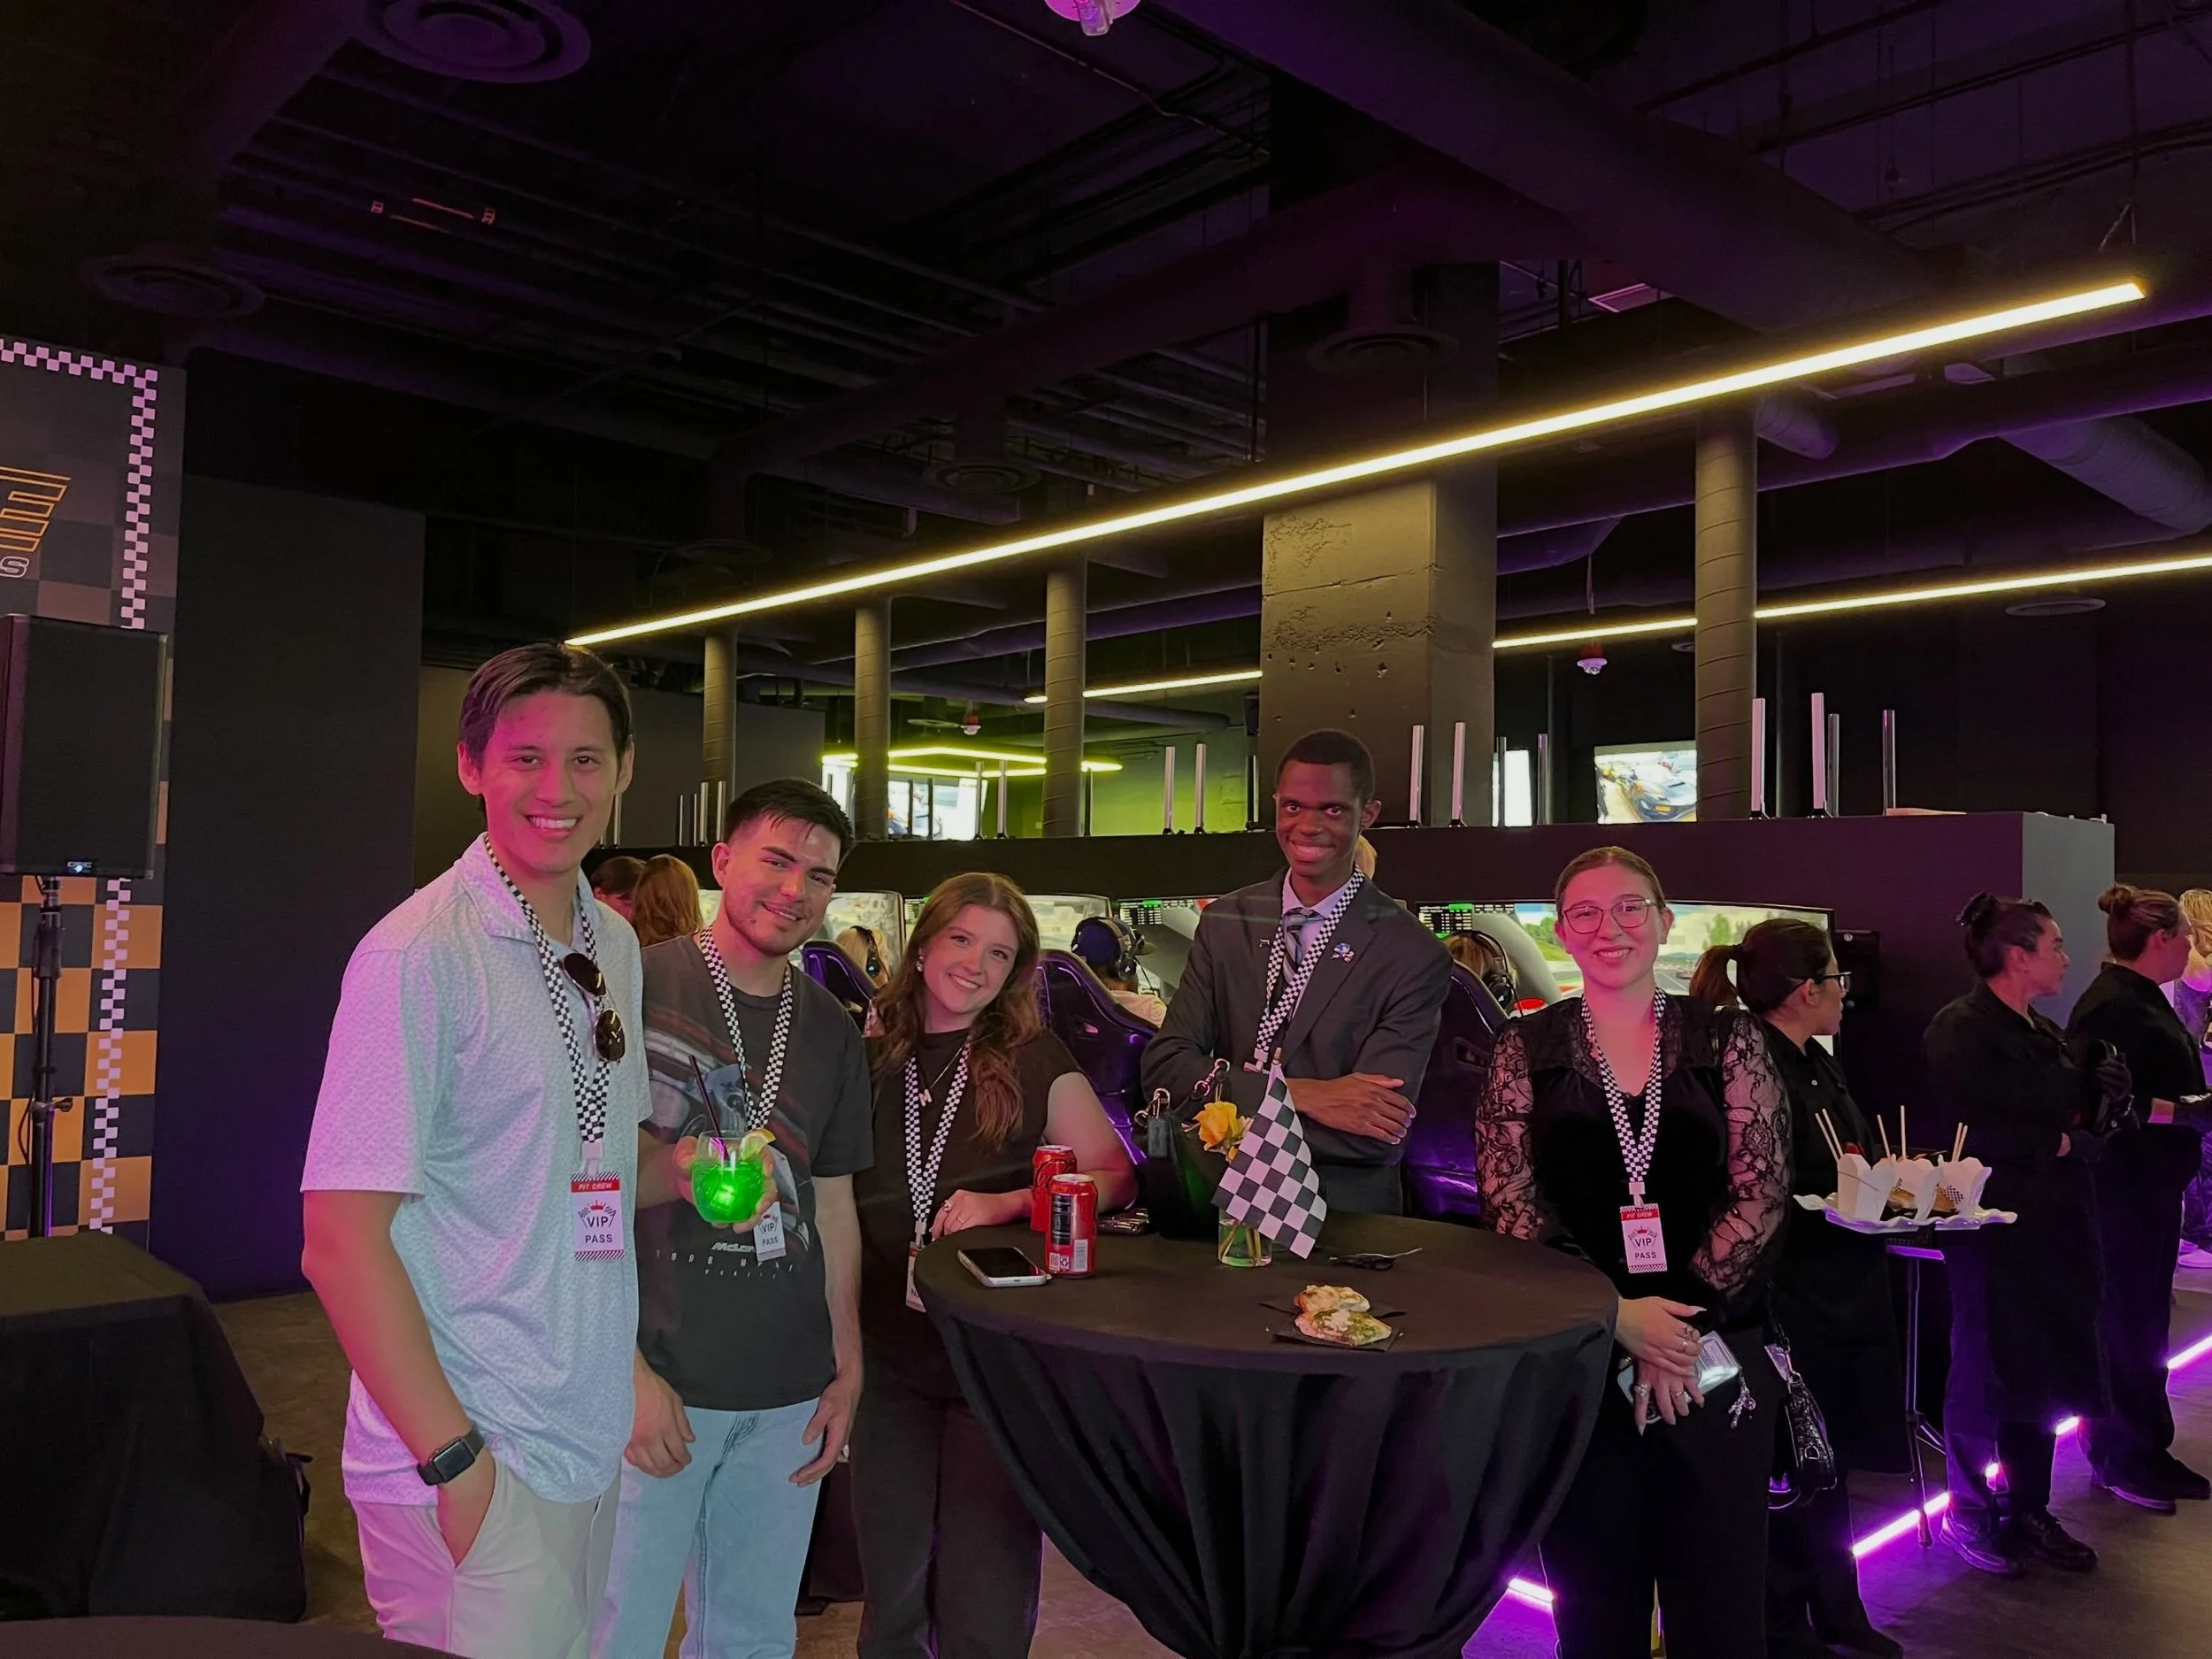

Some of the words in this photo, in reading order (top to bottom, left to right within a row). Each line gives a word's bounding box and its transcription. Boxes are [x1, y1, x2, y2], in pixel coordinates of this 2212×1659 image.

[587, 1216, 609, 1228] VIP
[762, 1223, 775, 1233] VIP
[585, 1233, 613, 1244] PASS
[762, 1236, 779, 1246] PASS
[1635, 1238, 1652, 1247] VIP
